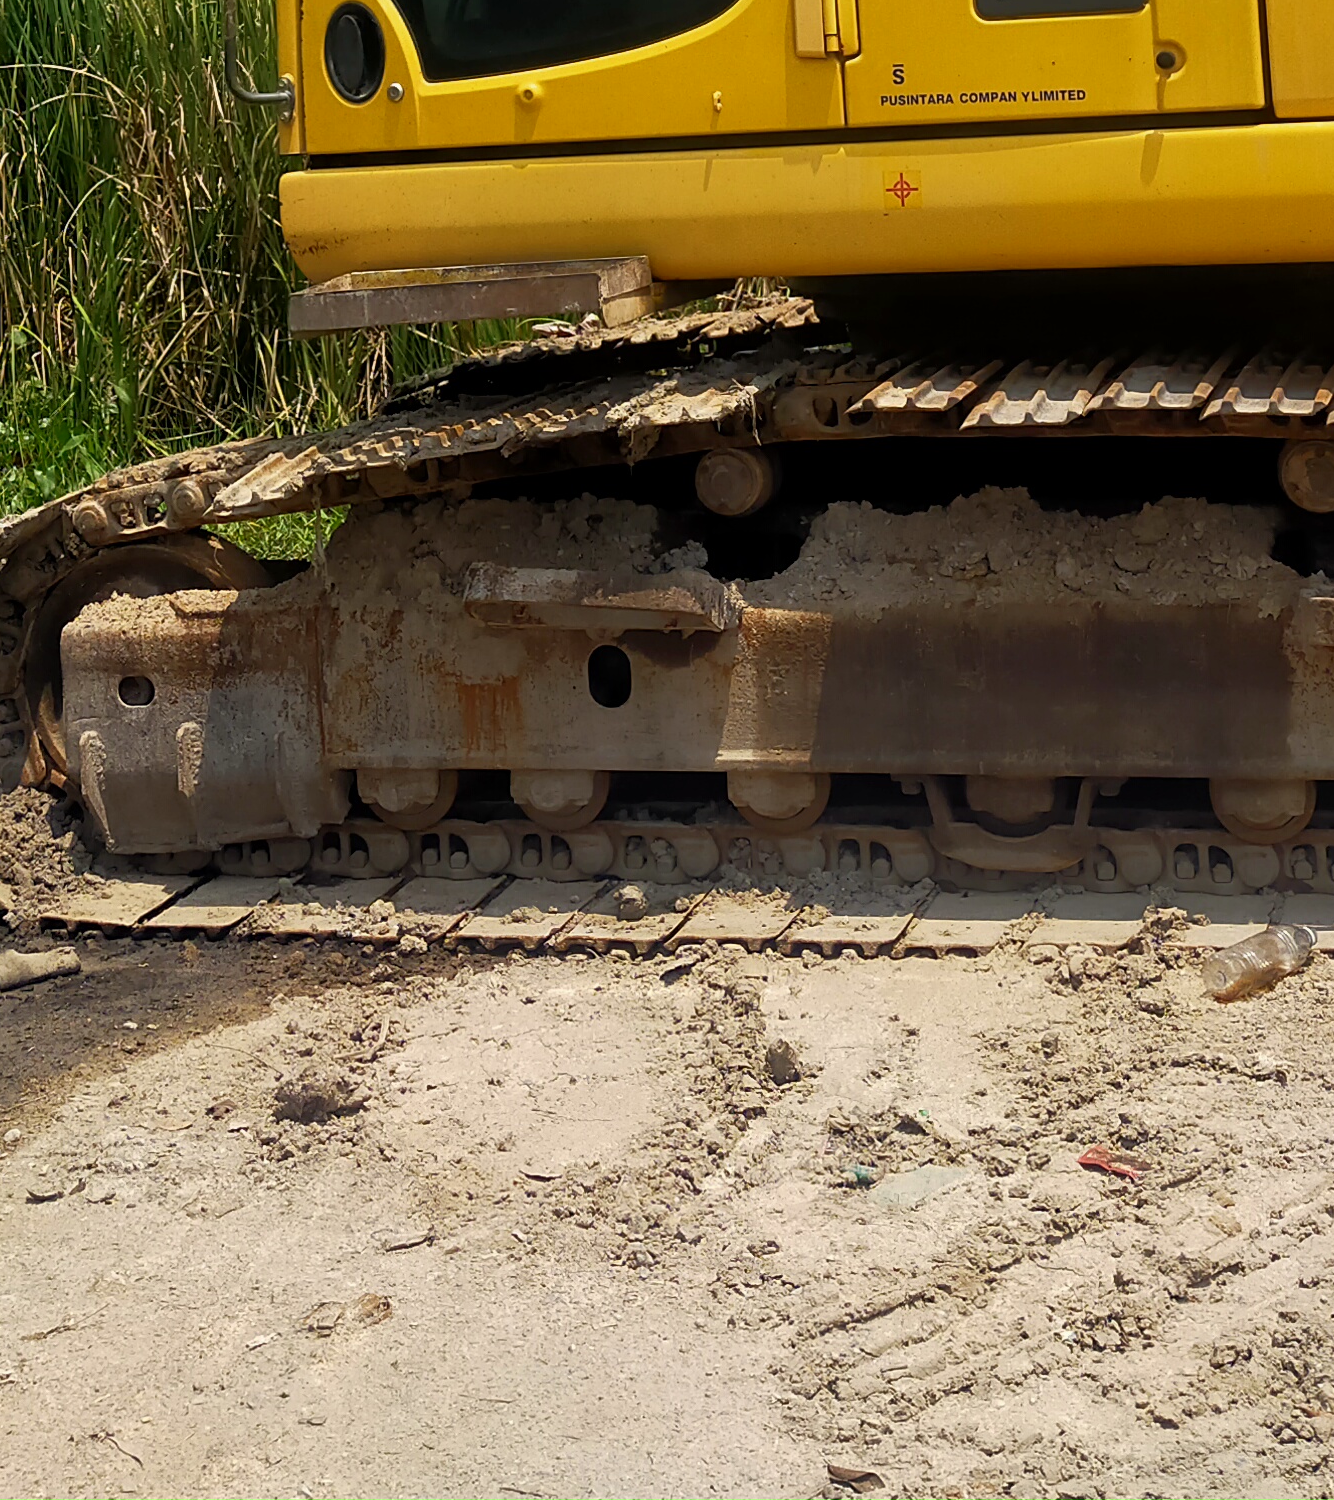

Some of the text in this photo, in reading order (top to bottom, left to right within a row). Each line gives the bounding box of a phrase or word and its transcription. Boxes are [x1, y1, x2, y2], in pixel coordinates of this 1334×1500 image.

[880, 89, 1086, 107] PUSINTARA COMPAN YLIMITED
